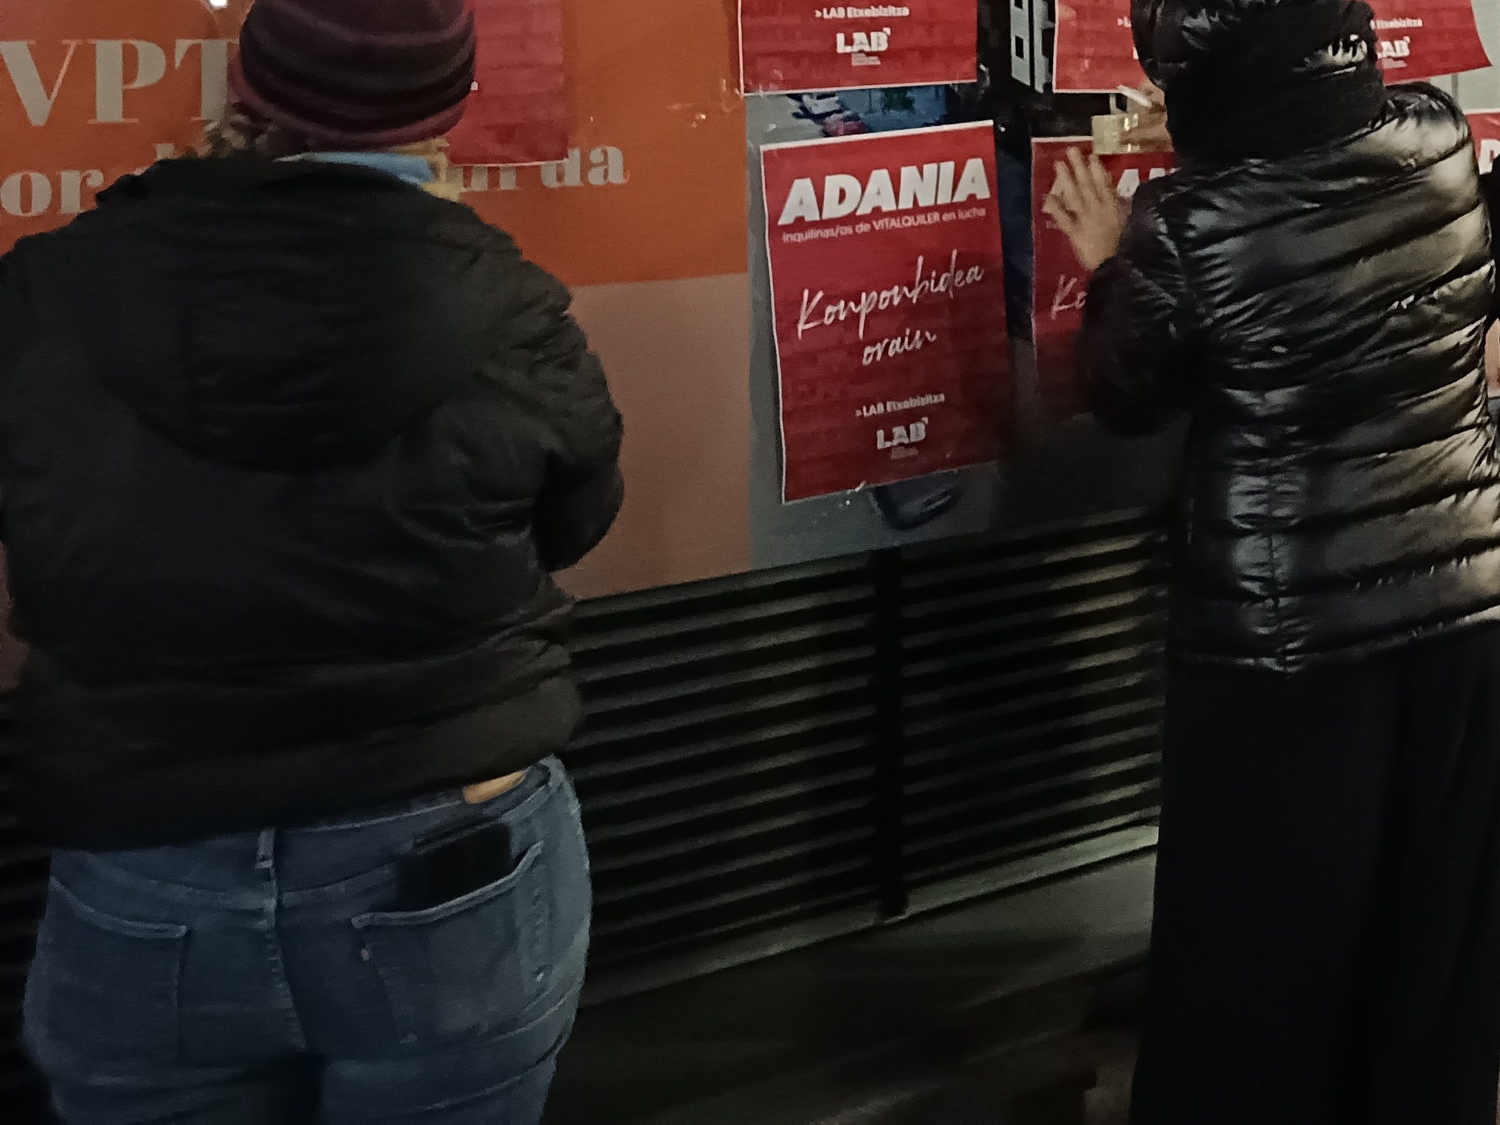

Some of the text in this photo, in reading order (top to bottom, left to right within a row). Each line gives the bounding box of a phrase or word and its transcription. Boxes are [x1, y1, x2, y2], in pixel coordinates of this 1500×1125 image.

[836, 29, 890, 54] LAB
[777, 157, 991, 226] ADANIA
[855, 221, 871, 234] de
[872, 211, 940, 231] VITALQUILER
[797, 248, 984, 341] Konponbidea
[862, 327, 938, 367] orain
[876, 419, 928, 450] LAB
